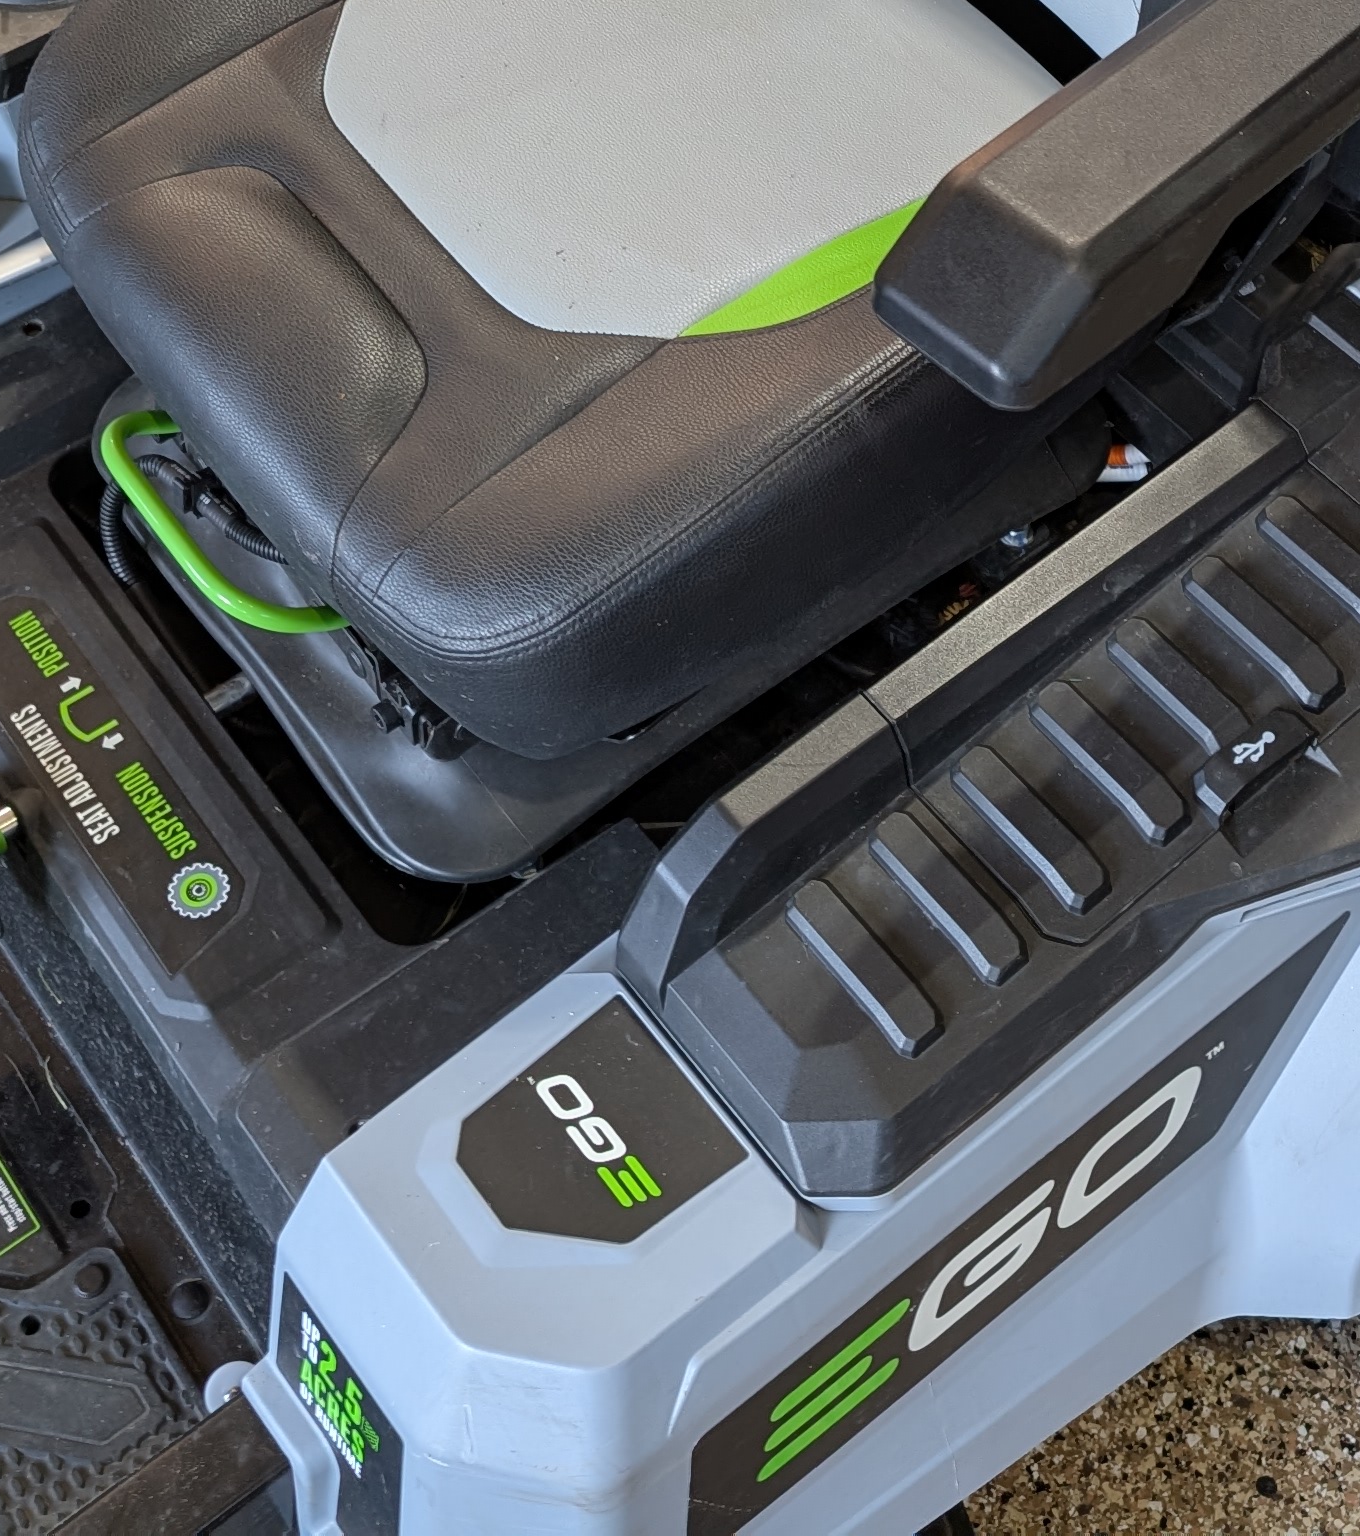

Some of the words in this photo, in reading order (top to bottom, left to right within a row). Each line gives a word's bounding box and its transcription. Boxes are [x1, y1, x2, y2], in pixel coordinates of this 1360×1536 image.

[7, 608, 70, 677] POSITION
[9, 701, 97, 809] ADJUSTMENTS
[75, 799, 121, 844] SEAT
[114, 760, 198, 860] SUSPENSION
[536, 1074, 662, 1208] EGO
[0, 1213, 19, 1233] Press
[756, 1066, 1202, 1482] EGO
[300, 1330, 319, 1365] TO
[301, 1312, 321, 1344] UP
[299, 1357, 365, 1464] ACRES
[317, 1339, 364, 1426] 2.5
[299, 1382, 314, 1407] OF
[314, 1402, 363, 1480] RUNTIME
